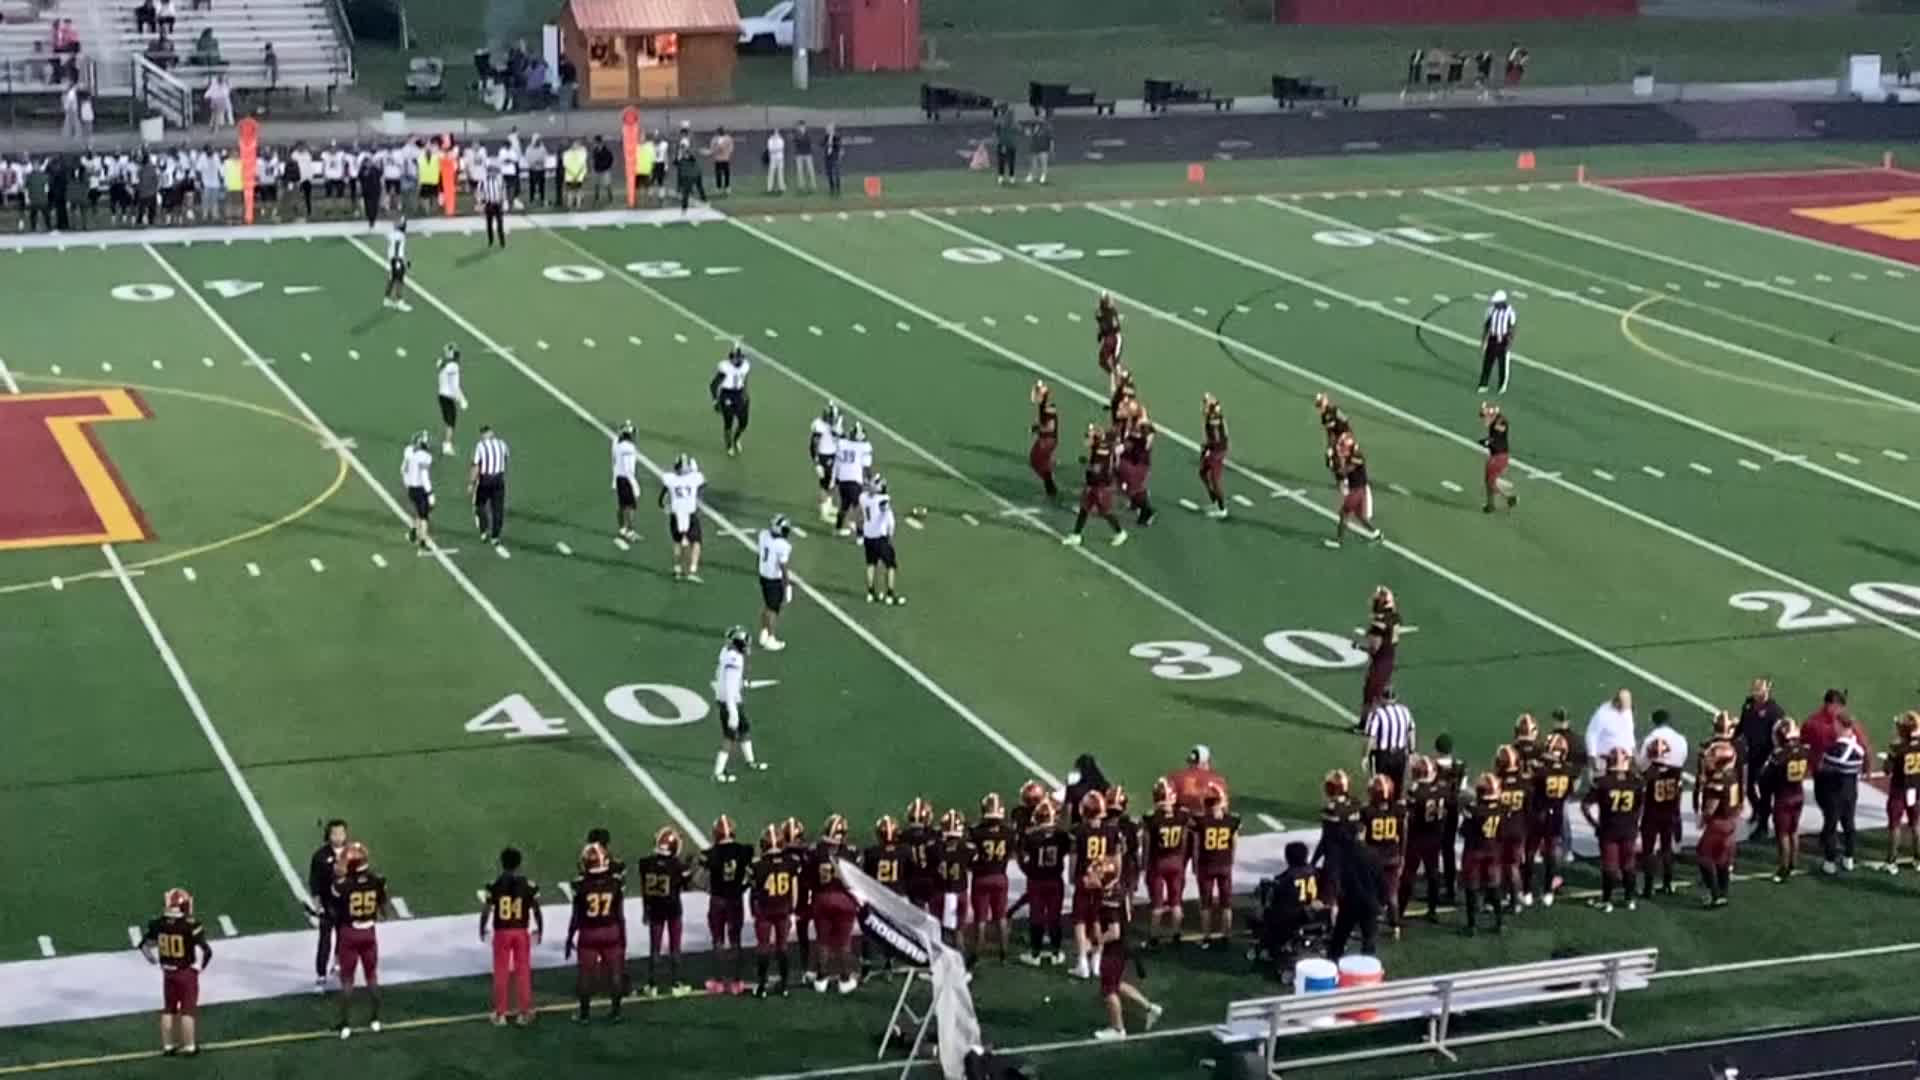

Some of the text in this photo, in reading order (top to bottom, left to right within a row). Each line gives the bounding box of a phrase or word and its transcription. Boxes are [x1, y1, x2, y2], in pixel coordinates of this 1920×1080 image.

[941, 242, 1084, 264] 20
[110, 279, 264, 302] 40
[1728, 581, 1920, 630] 20
[1119, 630, 1370, 680] 30
[464, 683, 708, 739] 40
[1608, 789, 1635, 812] 73
[1087, 835, 1107, 859] 81
[1204, 827, 1231, 850] 82
[877, 859, 898, 881] 21
[644, 872, 671, 897] 23
[763, 871, 791, 896] 46
[498, 894, 523, 920] 84
[586, 892, 614, 918] 37
